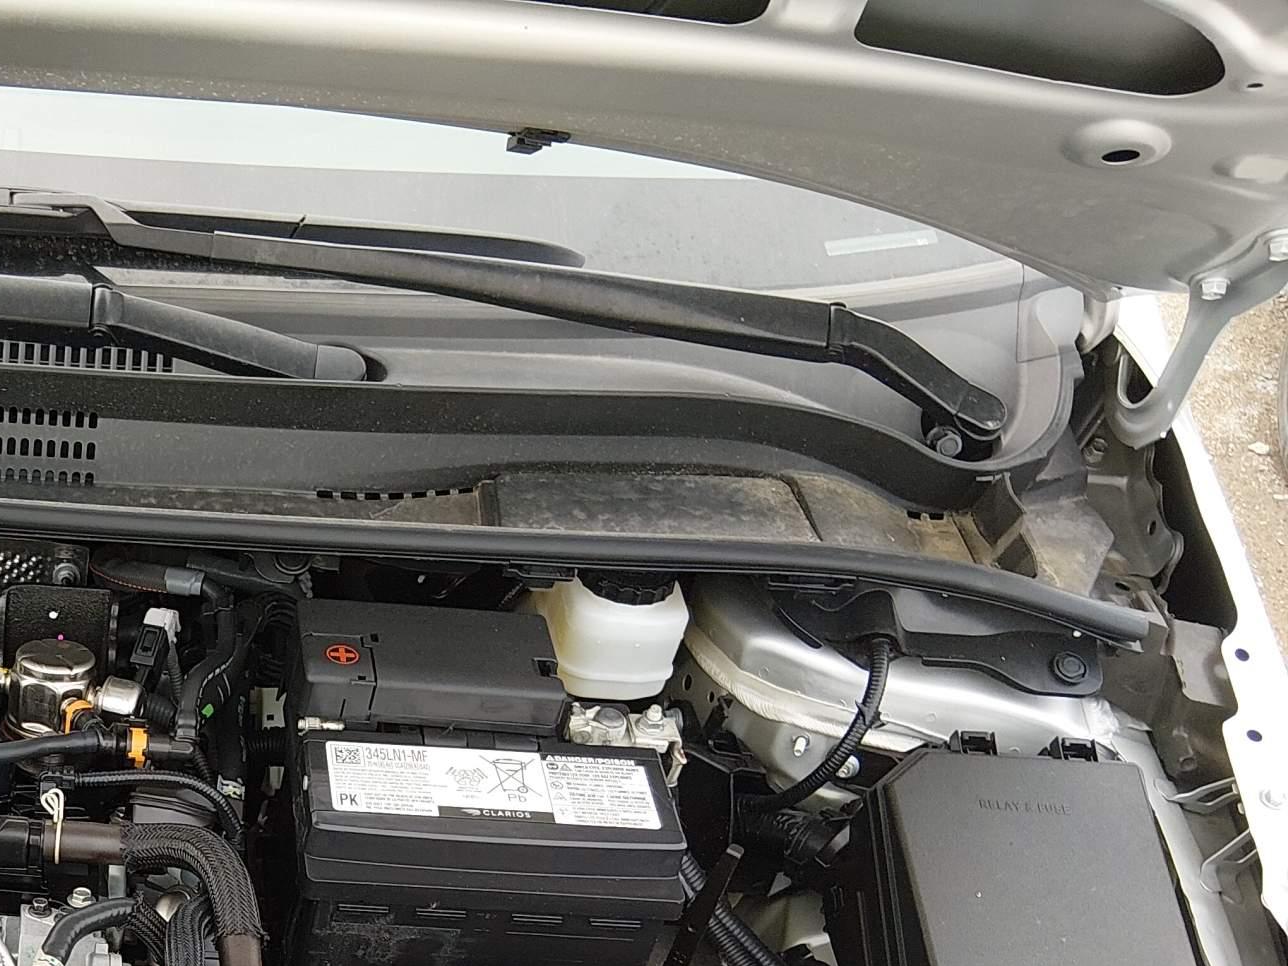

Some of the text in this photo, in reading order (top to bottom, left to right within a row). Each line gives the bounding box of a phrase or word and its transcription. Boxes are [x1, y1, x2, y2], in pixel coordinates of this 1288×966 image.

[365, 747, 429, 762] 345LN1-MF
[339, 793, 359, 807] PK
[507, 793, 527, 803] Pb
[482, 809, 532, 819] CLARIOS
